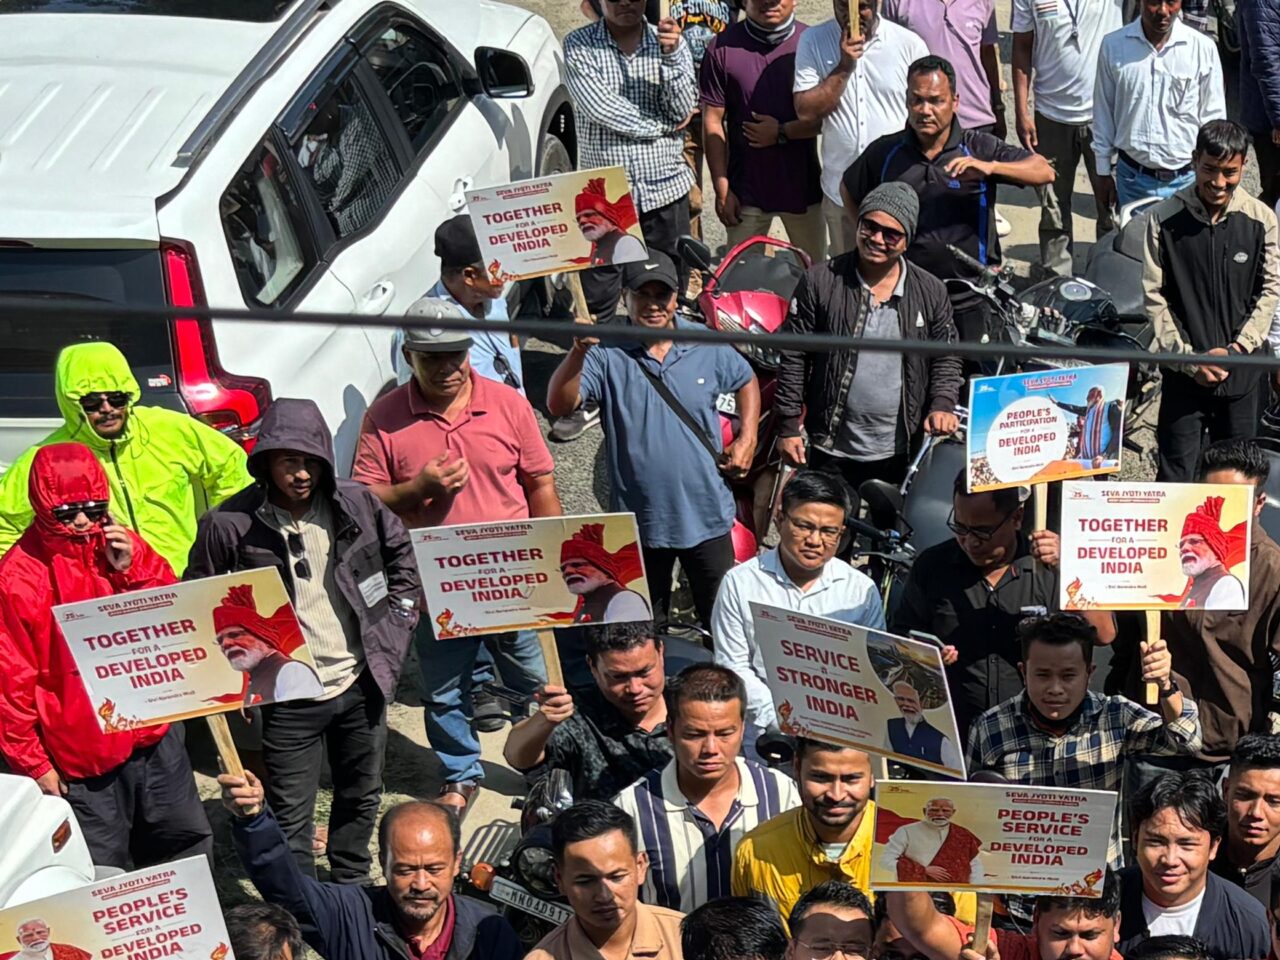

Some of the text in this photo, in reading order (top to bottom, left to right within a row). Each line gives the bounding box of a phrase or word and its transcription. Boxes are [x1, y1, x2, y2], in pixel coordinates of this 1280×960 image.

[483, 202, 563, 225] TOGETHER
[489, 223, 568, 245] DEVELOPED
[512, 238, 551, 253] INDIA
[1007, 408, 1051, 420] PEOPLE'S
[999, 416, 1057, 430] PARTICIPATION
[999, 432, 1056, 447] DEVELOPED
[1014, 445, 1040, 456] INDIA
[1078, 518, 1168, 532] TOGETHER
[434, 548, 544, 569] TOGETHER
[1077, 547, 1168, 559] DEVELOPED
[1101, 562, 1143, 574] INDIA
[440, 572, 549, 593] DEVELOPED
[472, 587, 523, 602] INDIA
[97, 602, 122, 613] SEVA
[123, 598, 147, 609] JYOTI
[148, 592, 178, 604] YATRA
[83, 619, 197, 651] TOGETHER
[131, 646, 151, 655] FOR
[780, 640, 860, 673] SERVICE
[95, 647, 208, 680] DEVELOPED
[129, 668, 184, 690] INDIA
[776, 666, 878, 704] STRONGER
[806, 695, 859, 721] INDIA
[1031, 792, 1057, 800] JYOTI
[997, 809, 1089, 824] PEOPLE'S
[1002, 822, 1082, 836] SERVICE
[990, 842, 1088, 855] DEVELOPED
[1011, 854, 1063, 866] INDIA
[91, 870, 176, 897] SEVA JYOTI YATRA
[92, 887, 188, 923] PEOPLE'S
[103, 903, 187, 935] SERVICE
[136, 927, 153, 936] FOR
[100, 923, 202, 959] DEVELOPED
